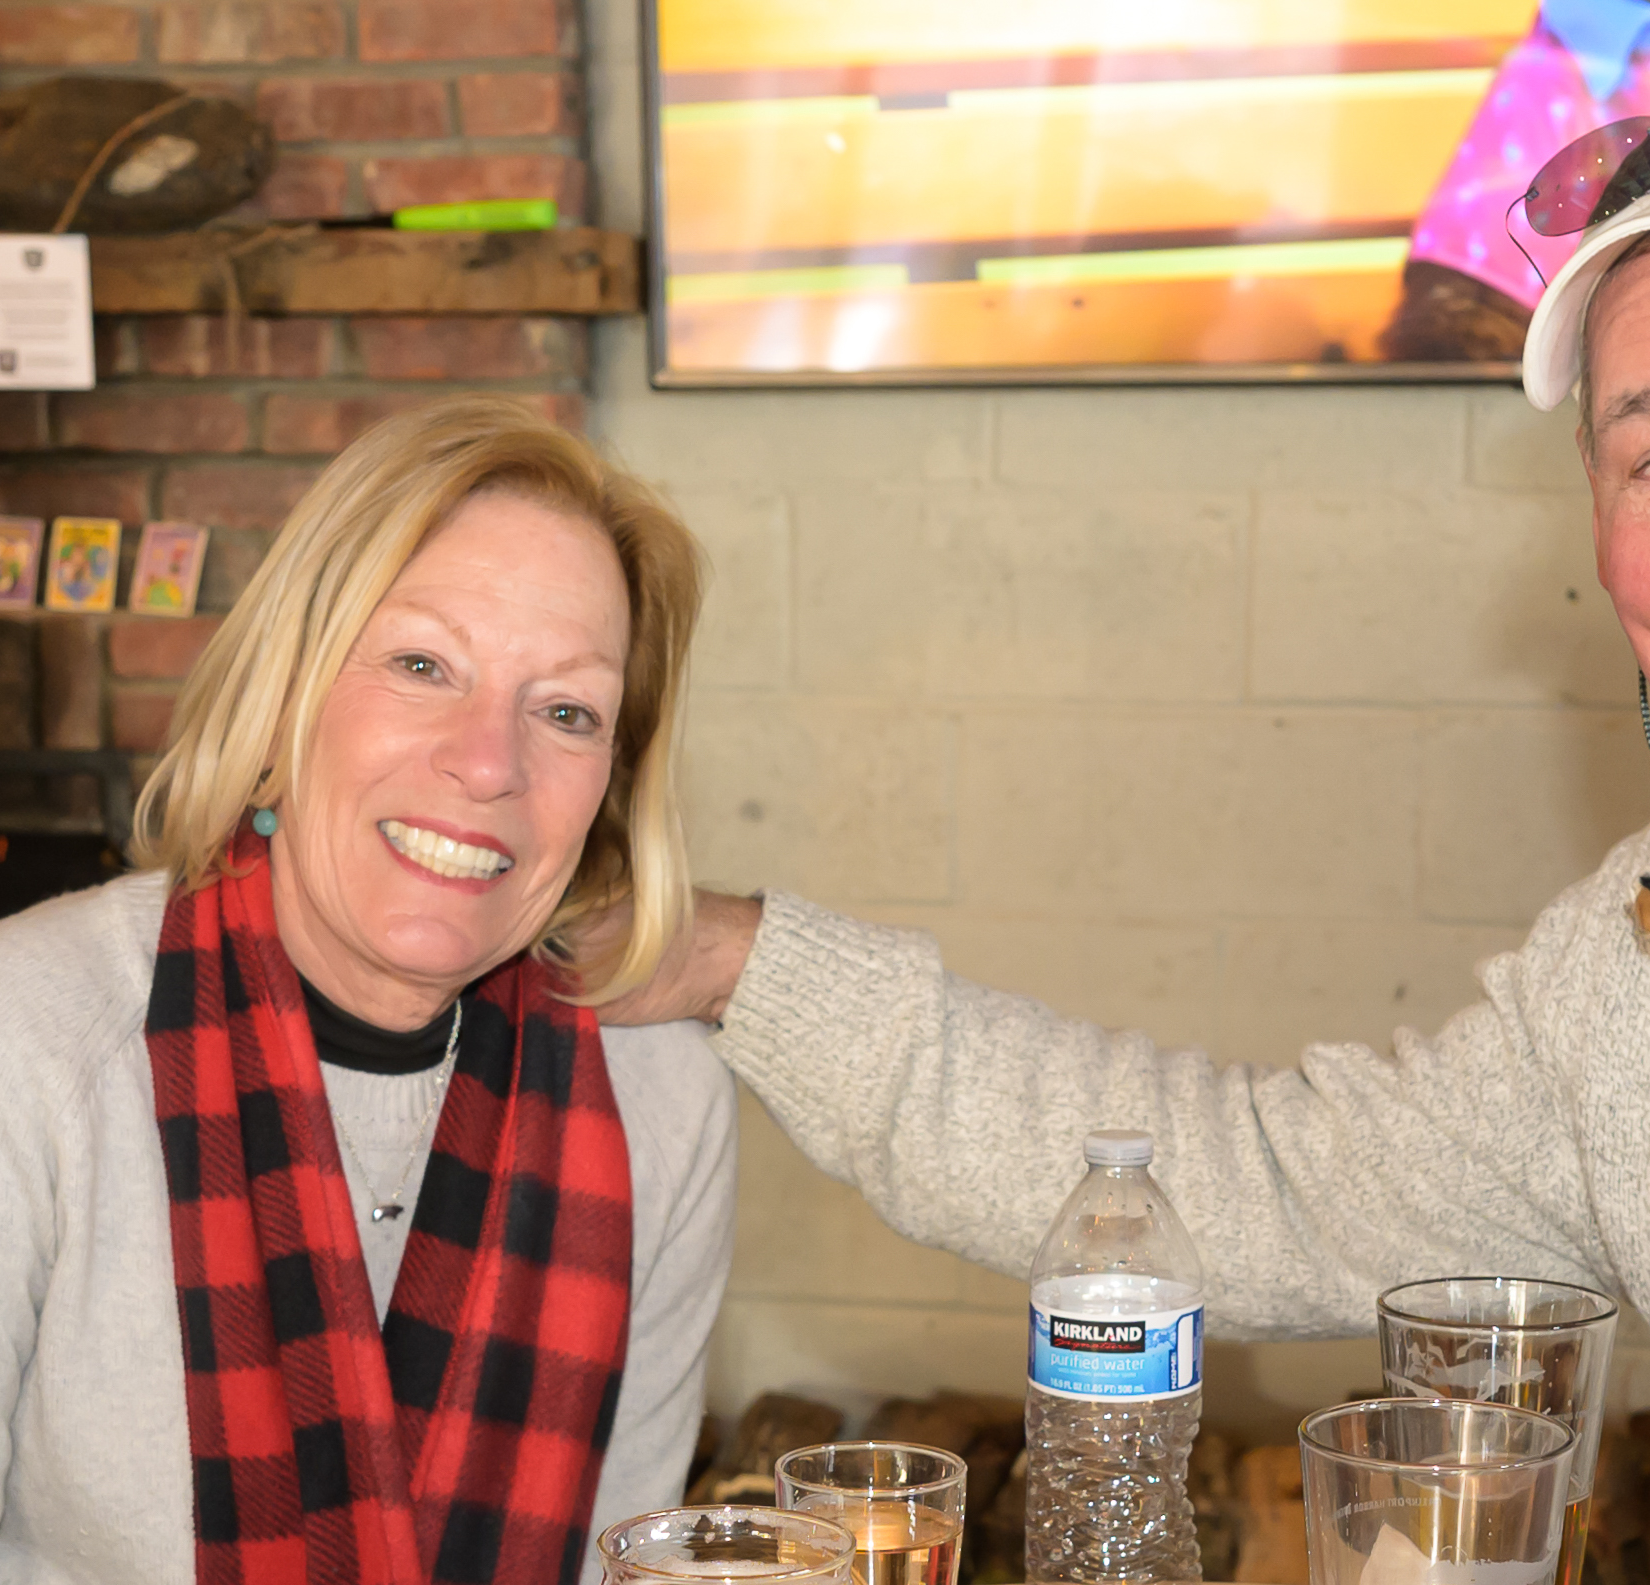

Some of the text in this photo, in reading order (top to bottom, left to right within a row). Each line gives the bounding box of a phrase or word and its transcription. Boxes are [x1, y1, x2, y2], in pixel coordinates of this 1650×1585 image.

[1053, 1320, 1143, 1342] KIRKLAND
[1050, 1353, 1146, 1371] purified water
[1063, 1380, 1072, 1390] FL
